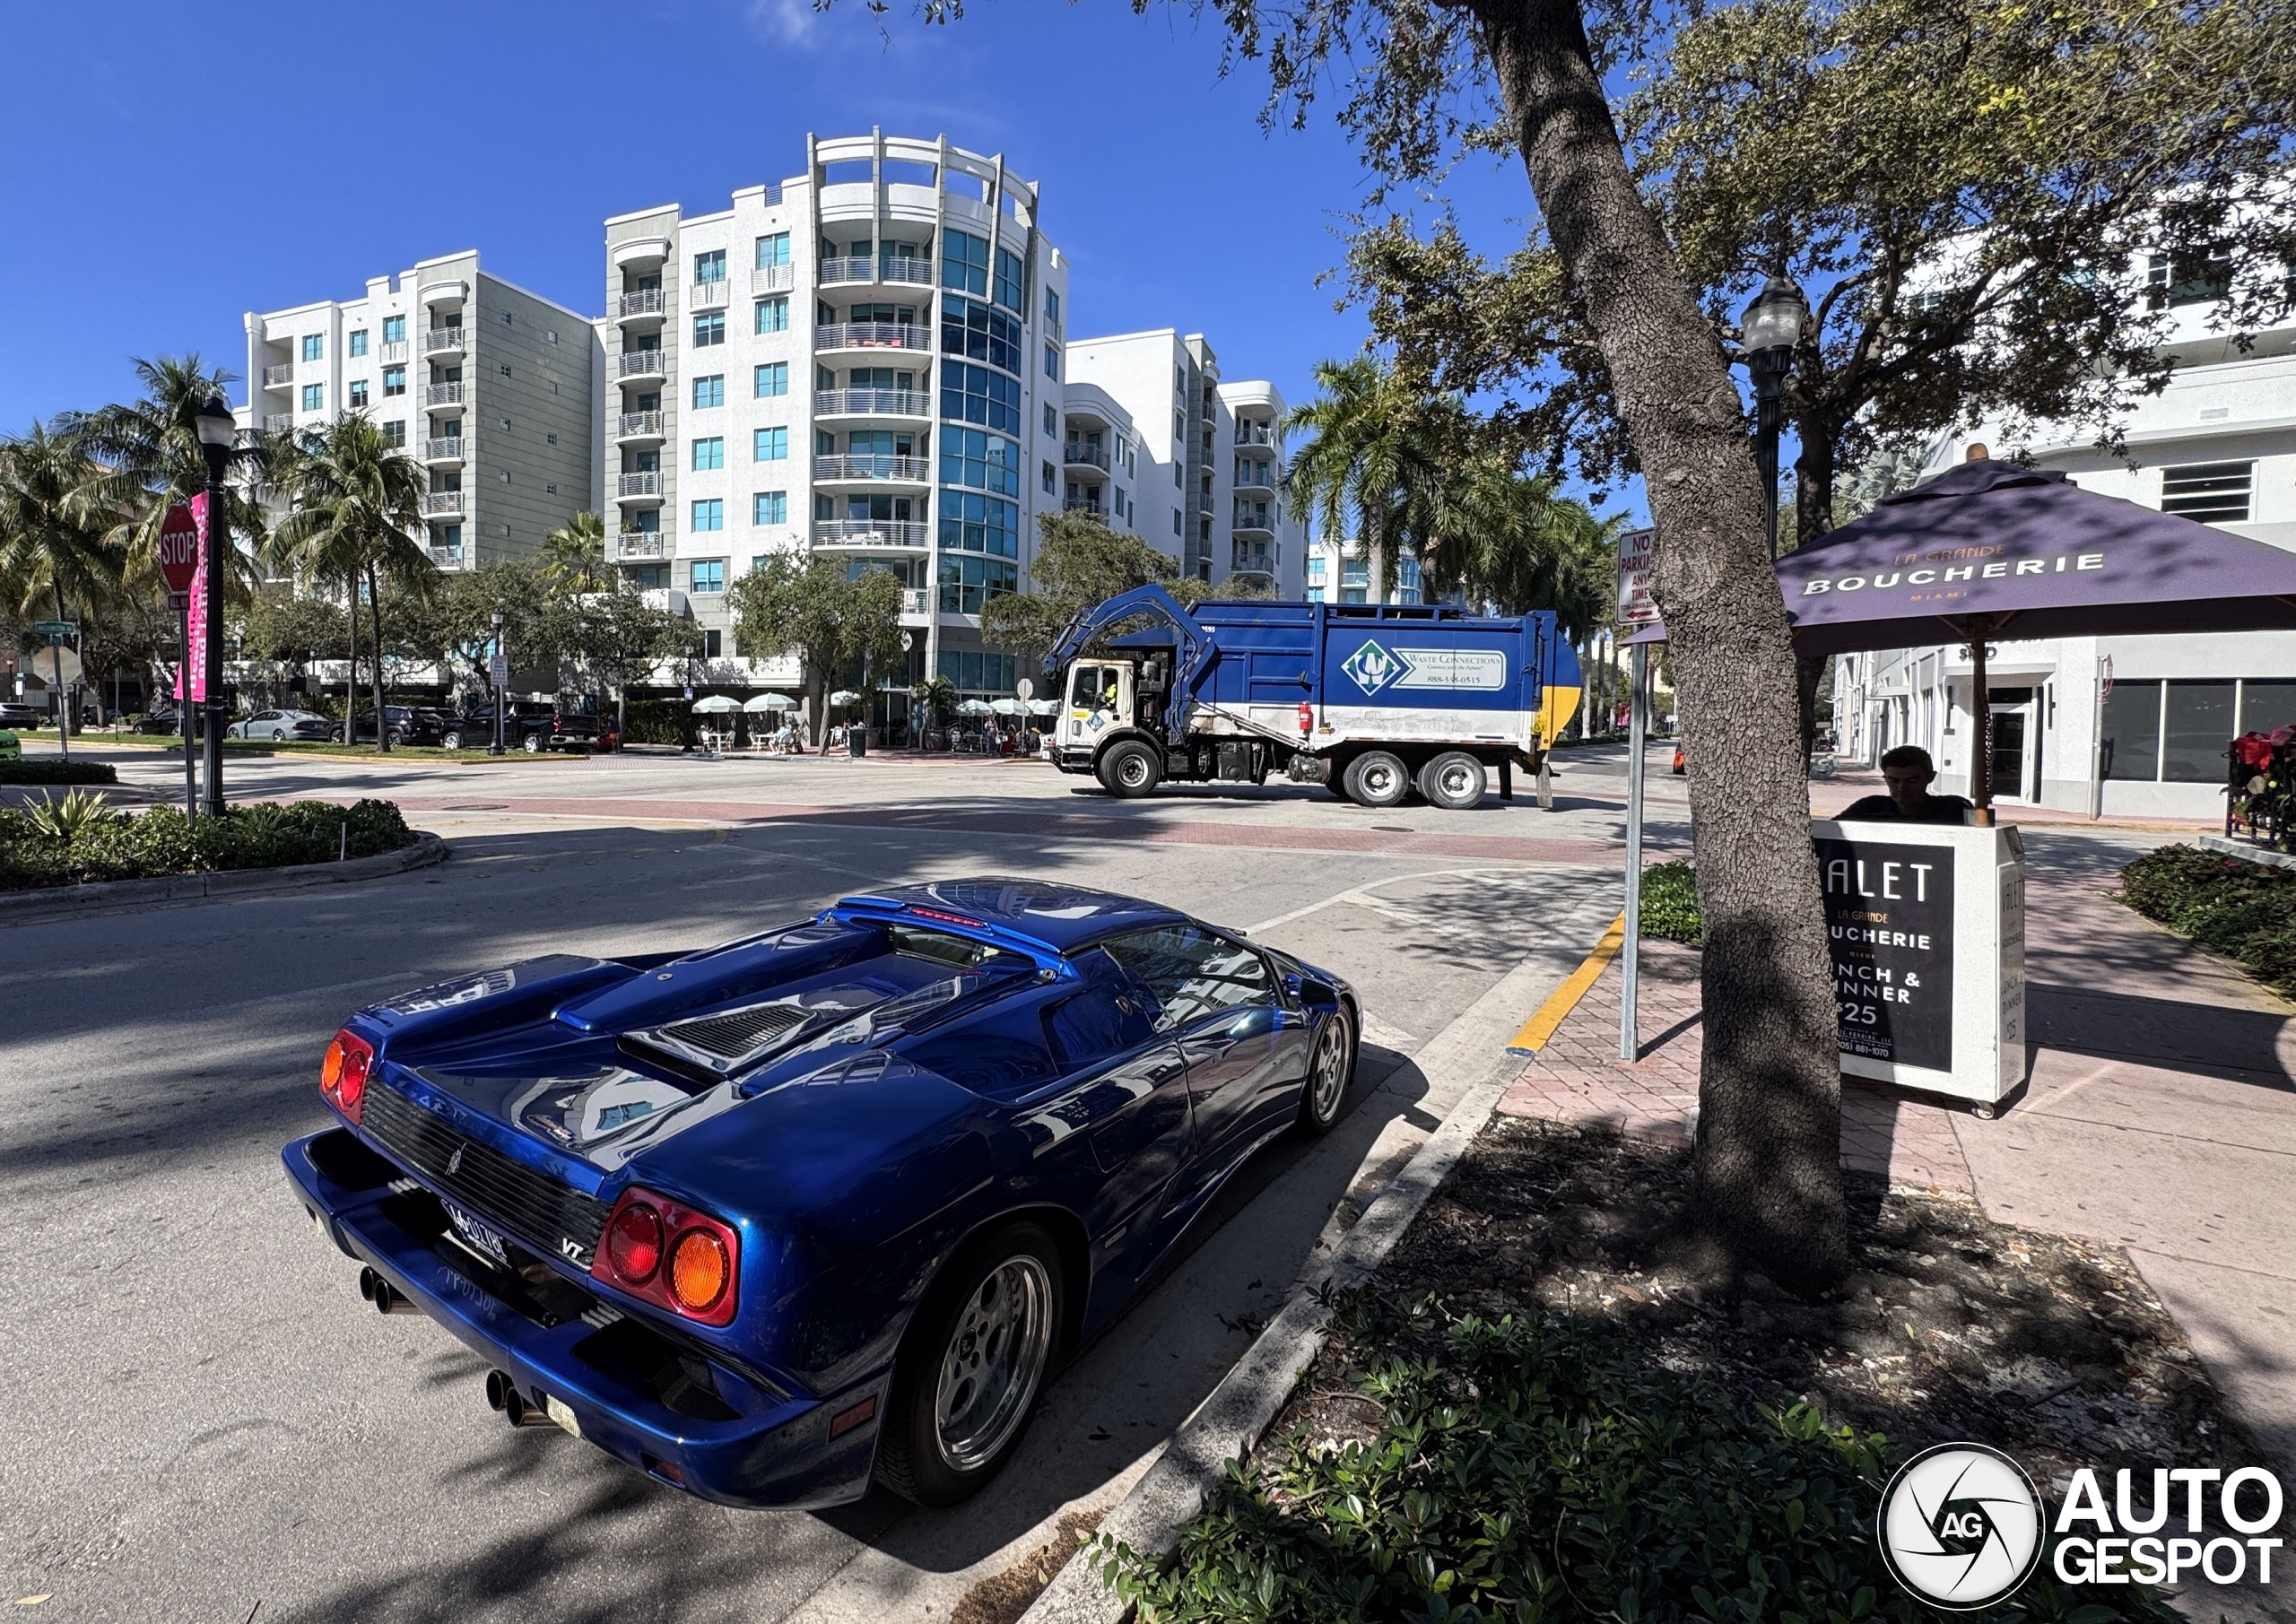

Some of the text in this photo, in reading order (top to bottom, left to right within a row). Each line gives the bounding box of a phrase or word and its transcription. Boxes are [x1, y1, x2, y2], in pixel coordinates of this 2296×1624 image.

[162, 531, 196, 565] STOP
[1633, 534, 1650, 552] NO
[1622, 554, 1650, 573] PARKI
[1894, 543, 2007, 566] LA GRANDE
[1802, 553, 2104, 595] BOUCHERIE
[1632, 587, 1648, 601] TIME
[1910, 591, 1969, 603] MIAMI
[1408, 654, 1500, 664] WASTE CONNECTIONS
[1827, 858, 1933, 902] ALET
[1837, 908, 1888, 924] LA GRANDE
[1831, 925, 1931, 950] UCHERIE
[1830, 962, 1920, 987] NCH &
[1834, 979, 1910, 1004] INNER
[1836, 1002, 1876, 1024] $25
[562, 1238, 584, 1259] VT
